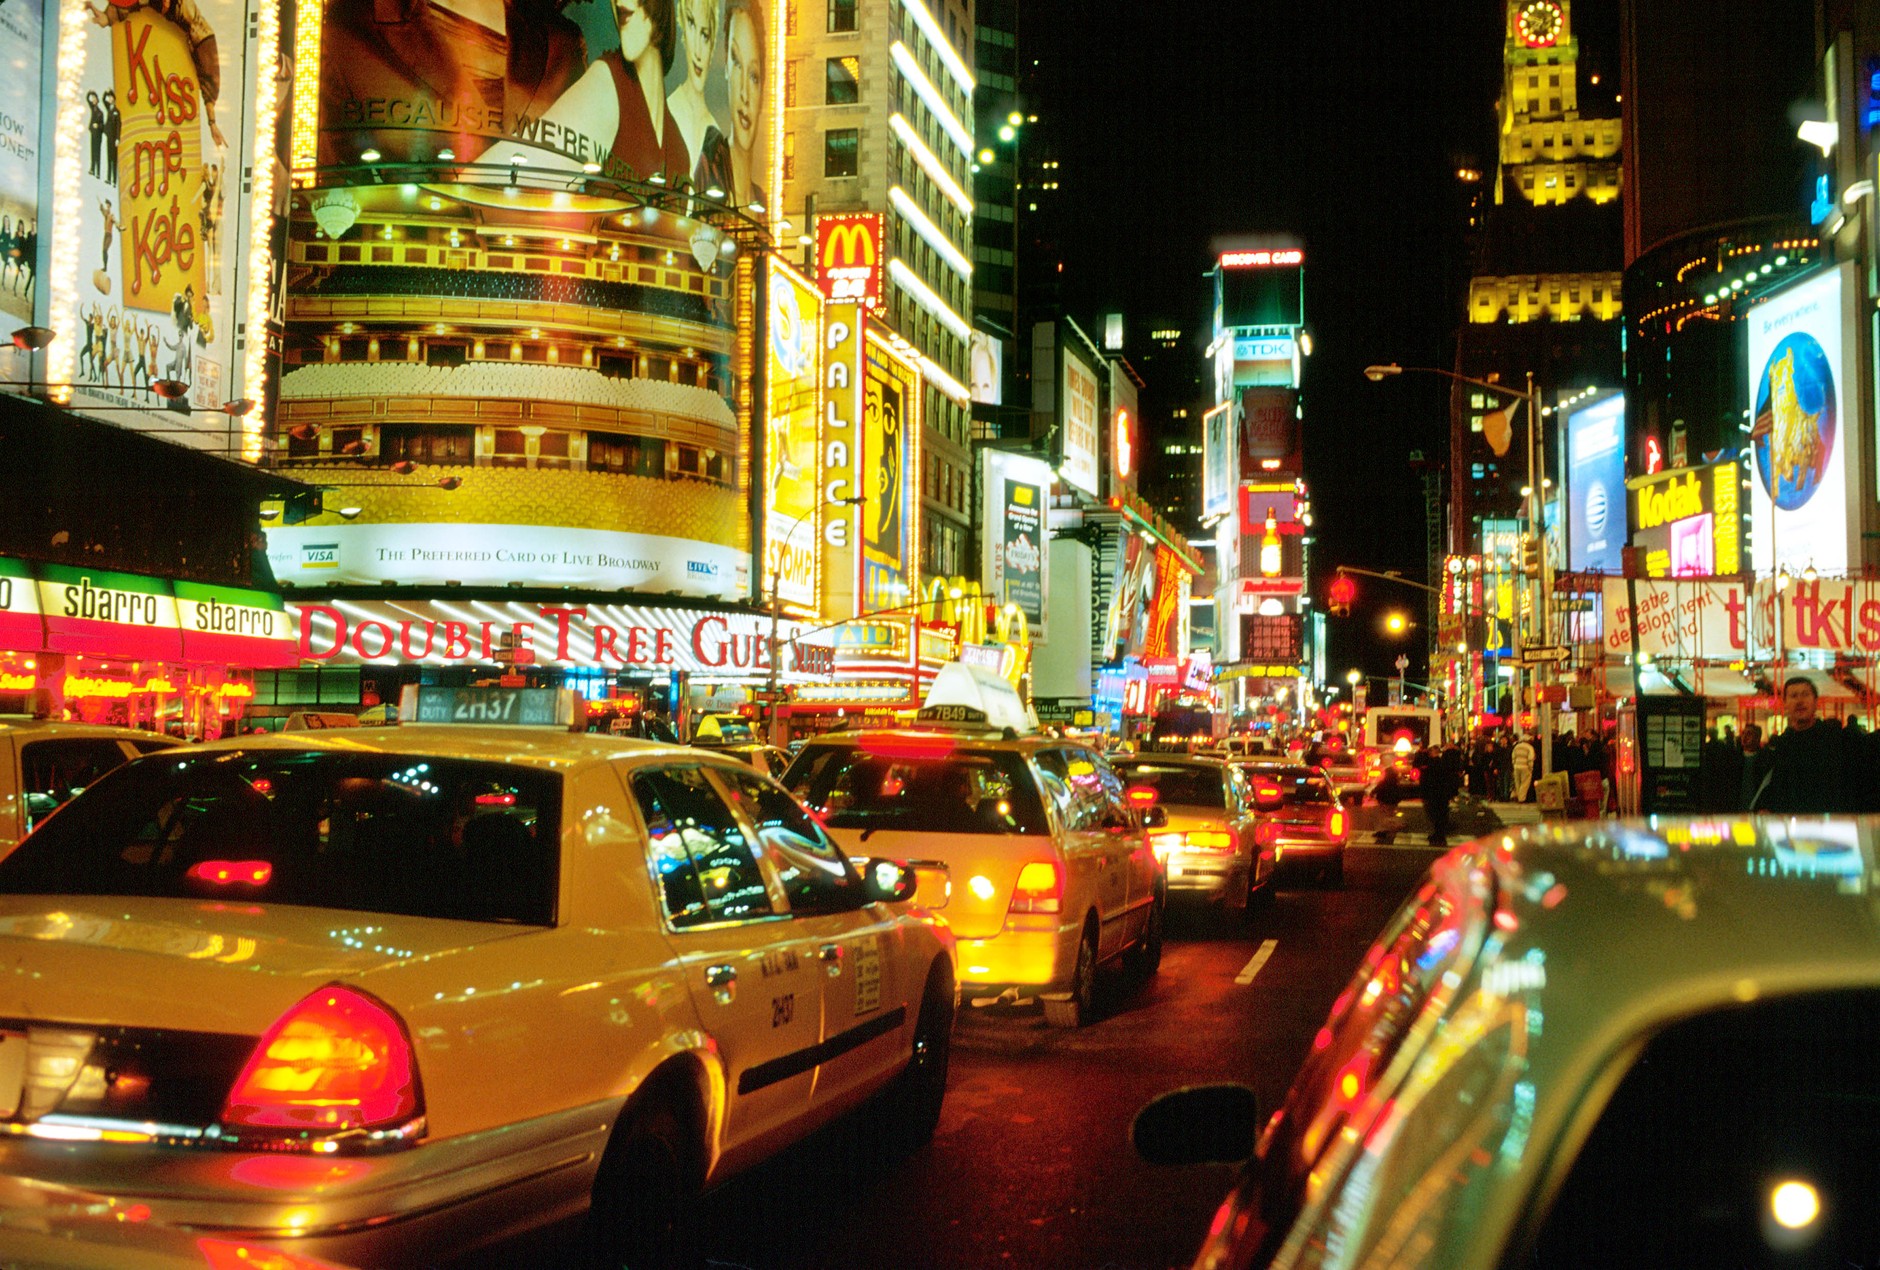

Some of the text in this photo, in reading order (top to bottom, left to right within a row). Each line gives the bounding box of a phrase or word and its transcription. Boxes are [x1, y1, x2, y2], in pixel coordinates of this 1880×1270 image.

[343, 97, 504, 134] BECAUSE
[513, 113, 590, 163] WE'RE
[132, 195, 195, 295] Kate
[1248, 343, 1286, 355] TDK
[824, 322, 850, 547] PALACE
[1638, 471, 1703, 530] Kodak
[307, 551, 334, 561] VISA
[377, 548, 405, 561] THE
[412, 548, 491, 562] PREFERRED
[496, 548, 536, 563] CARD
[541, 553, 558, 563] OF
[563, 552, 593, 565] LIVE
[598, 553, 661, 571] BROADWAY
[767, 538, 813, 587] STOMP
[64, 577, 157, 624] sbarro
[196, 597, 273, 636] sbarro
[1792, 579, 1880, 651] tkts
[421, 706, 447, 718] DUTY
[936, 706, 966, 720] 7B49
